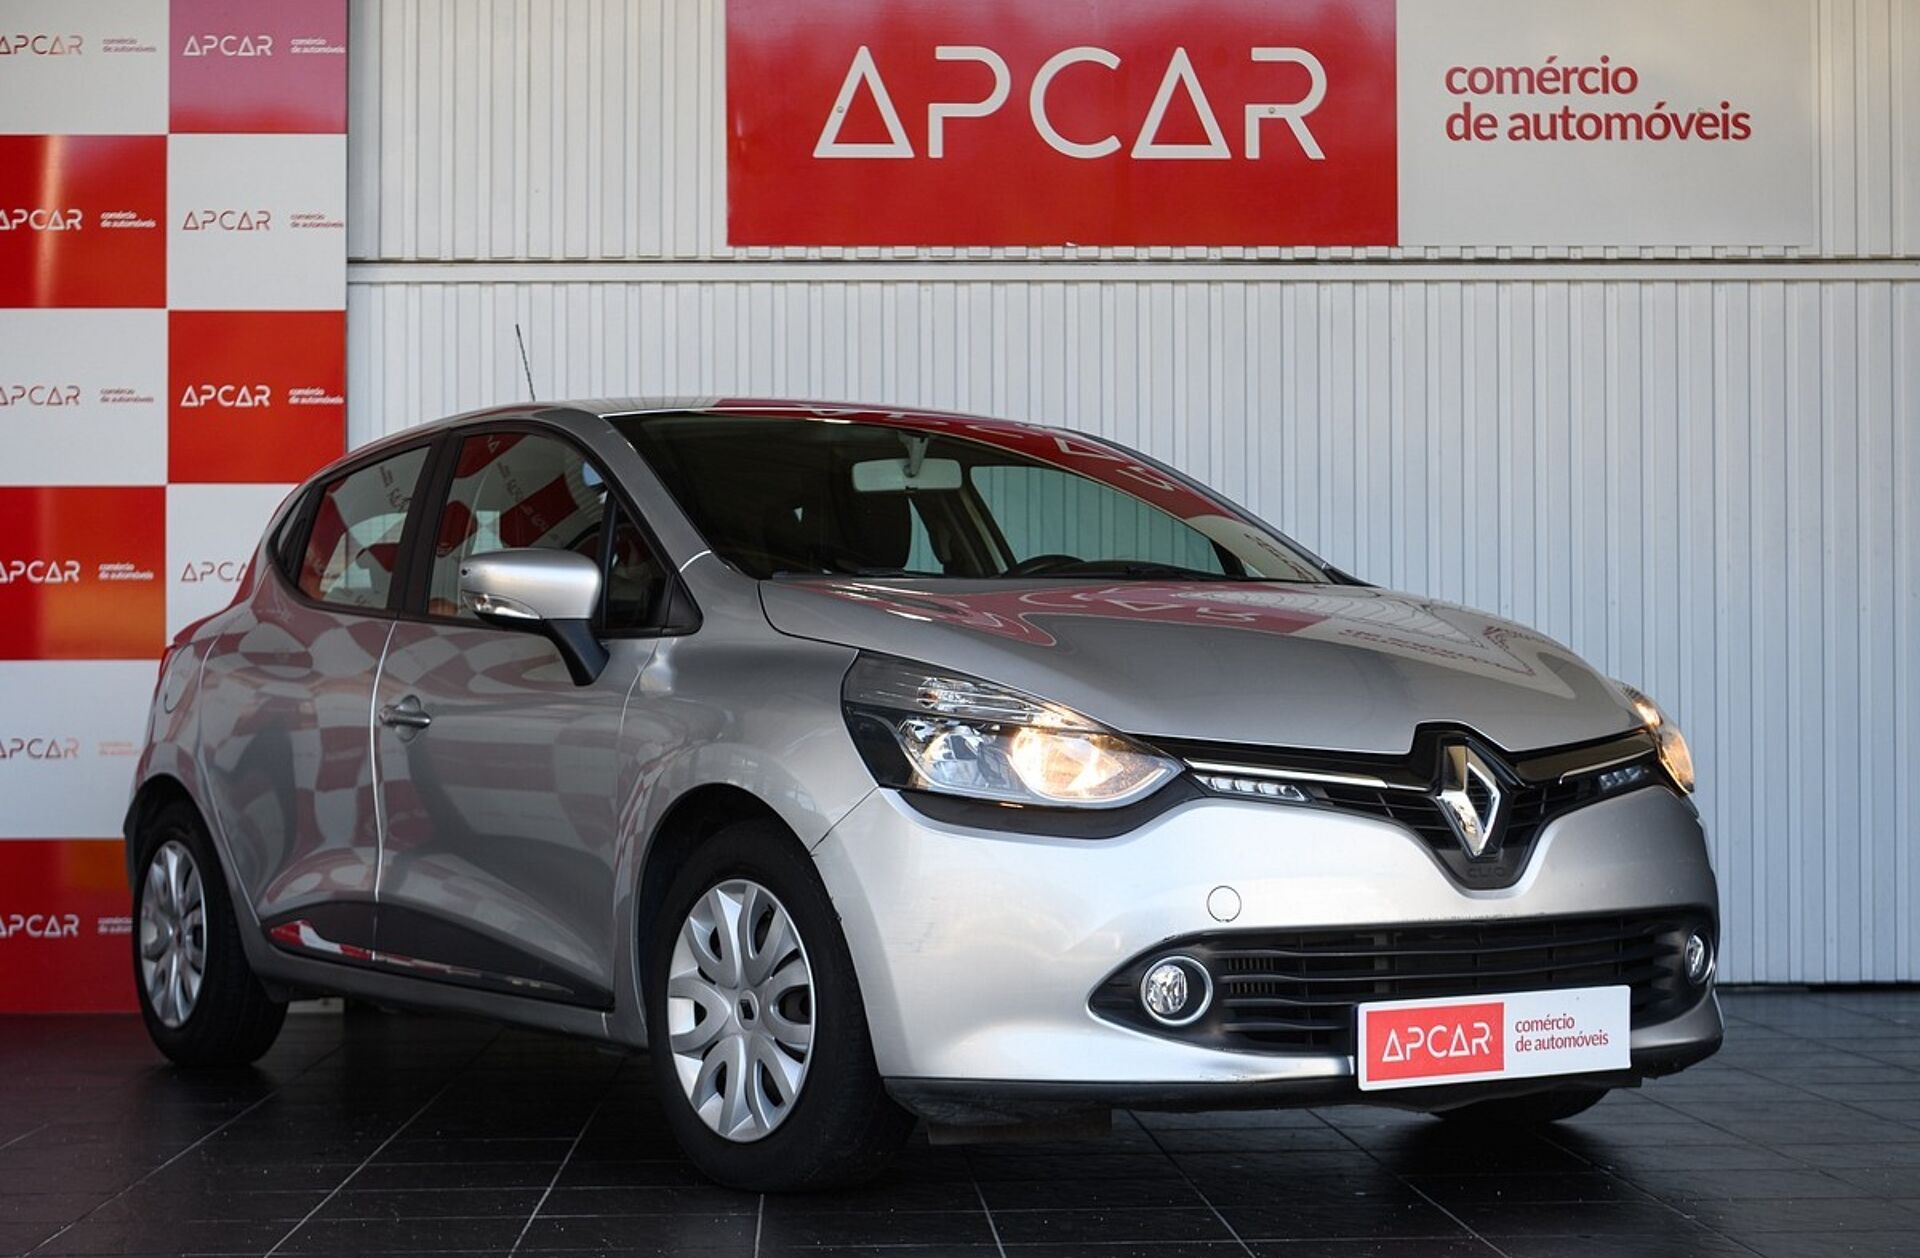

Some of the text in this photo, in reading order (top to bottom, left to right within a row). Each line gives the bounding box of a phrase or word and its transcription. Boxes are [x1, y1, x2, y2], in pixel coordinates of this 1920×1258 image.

[183, 35, 273, 56] APCAR
[1445, 55, 1638, 95] comércio
[813, 46, 1328, 160] APCAR
[1446, 101, 1752, 142] de automóveis
[183, 210, 271, 231] APCAR
[180, 385, 271, 407] APCAR
[1515, 1013, 1575, 1032] comércio
[1382, 1022, 1491, 1062] APCAR
[1515, 1028, 1609, 1052] de automóveis
